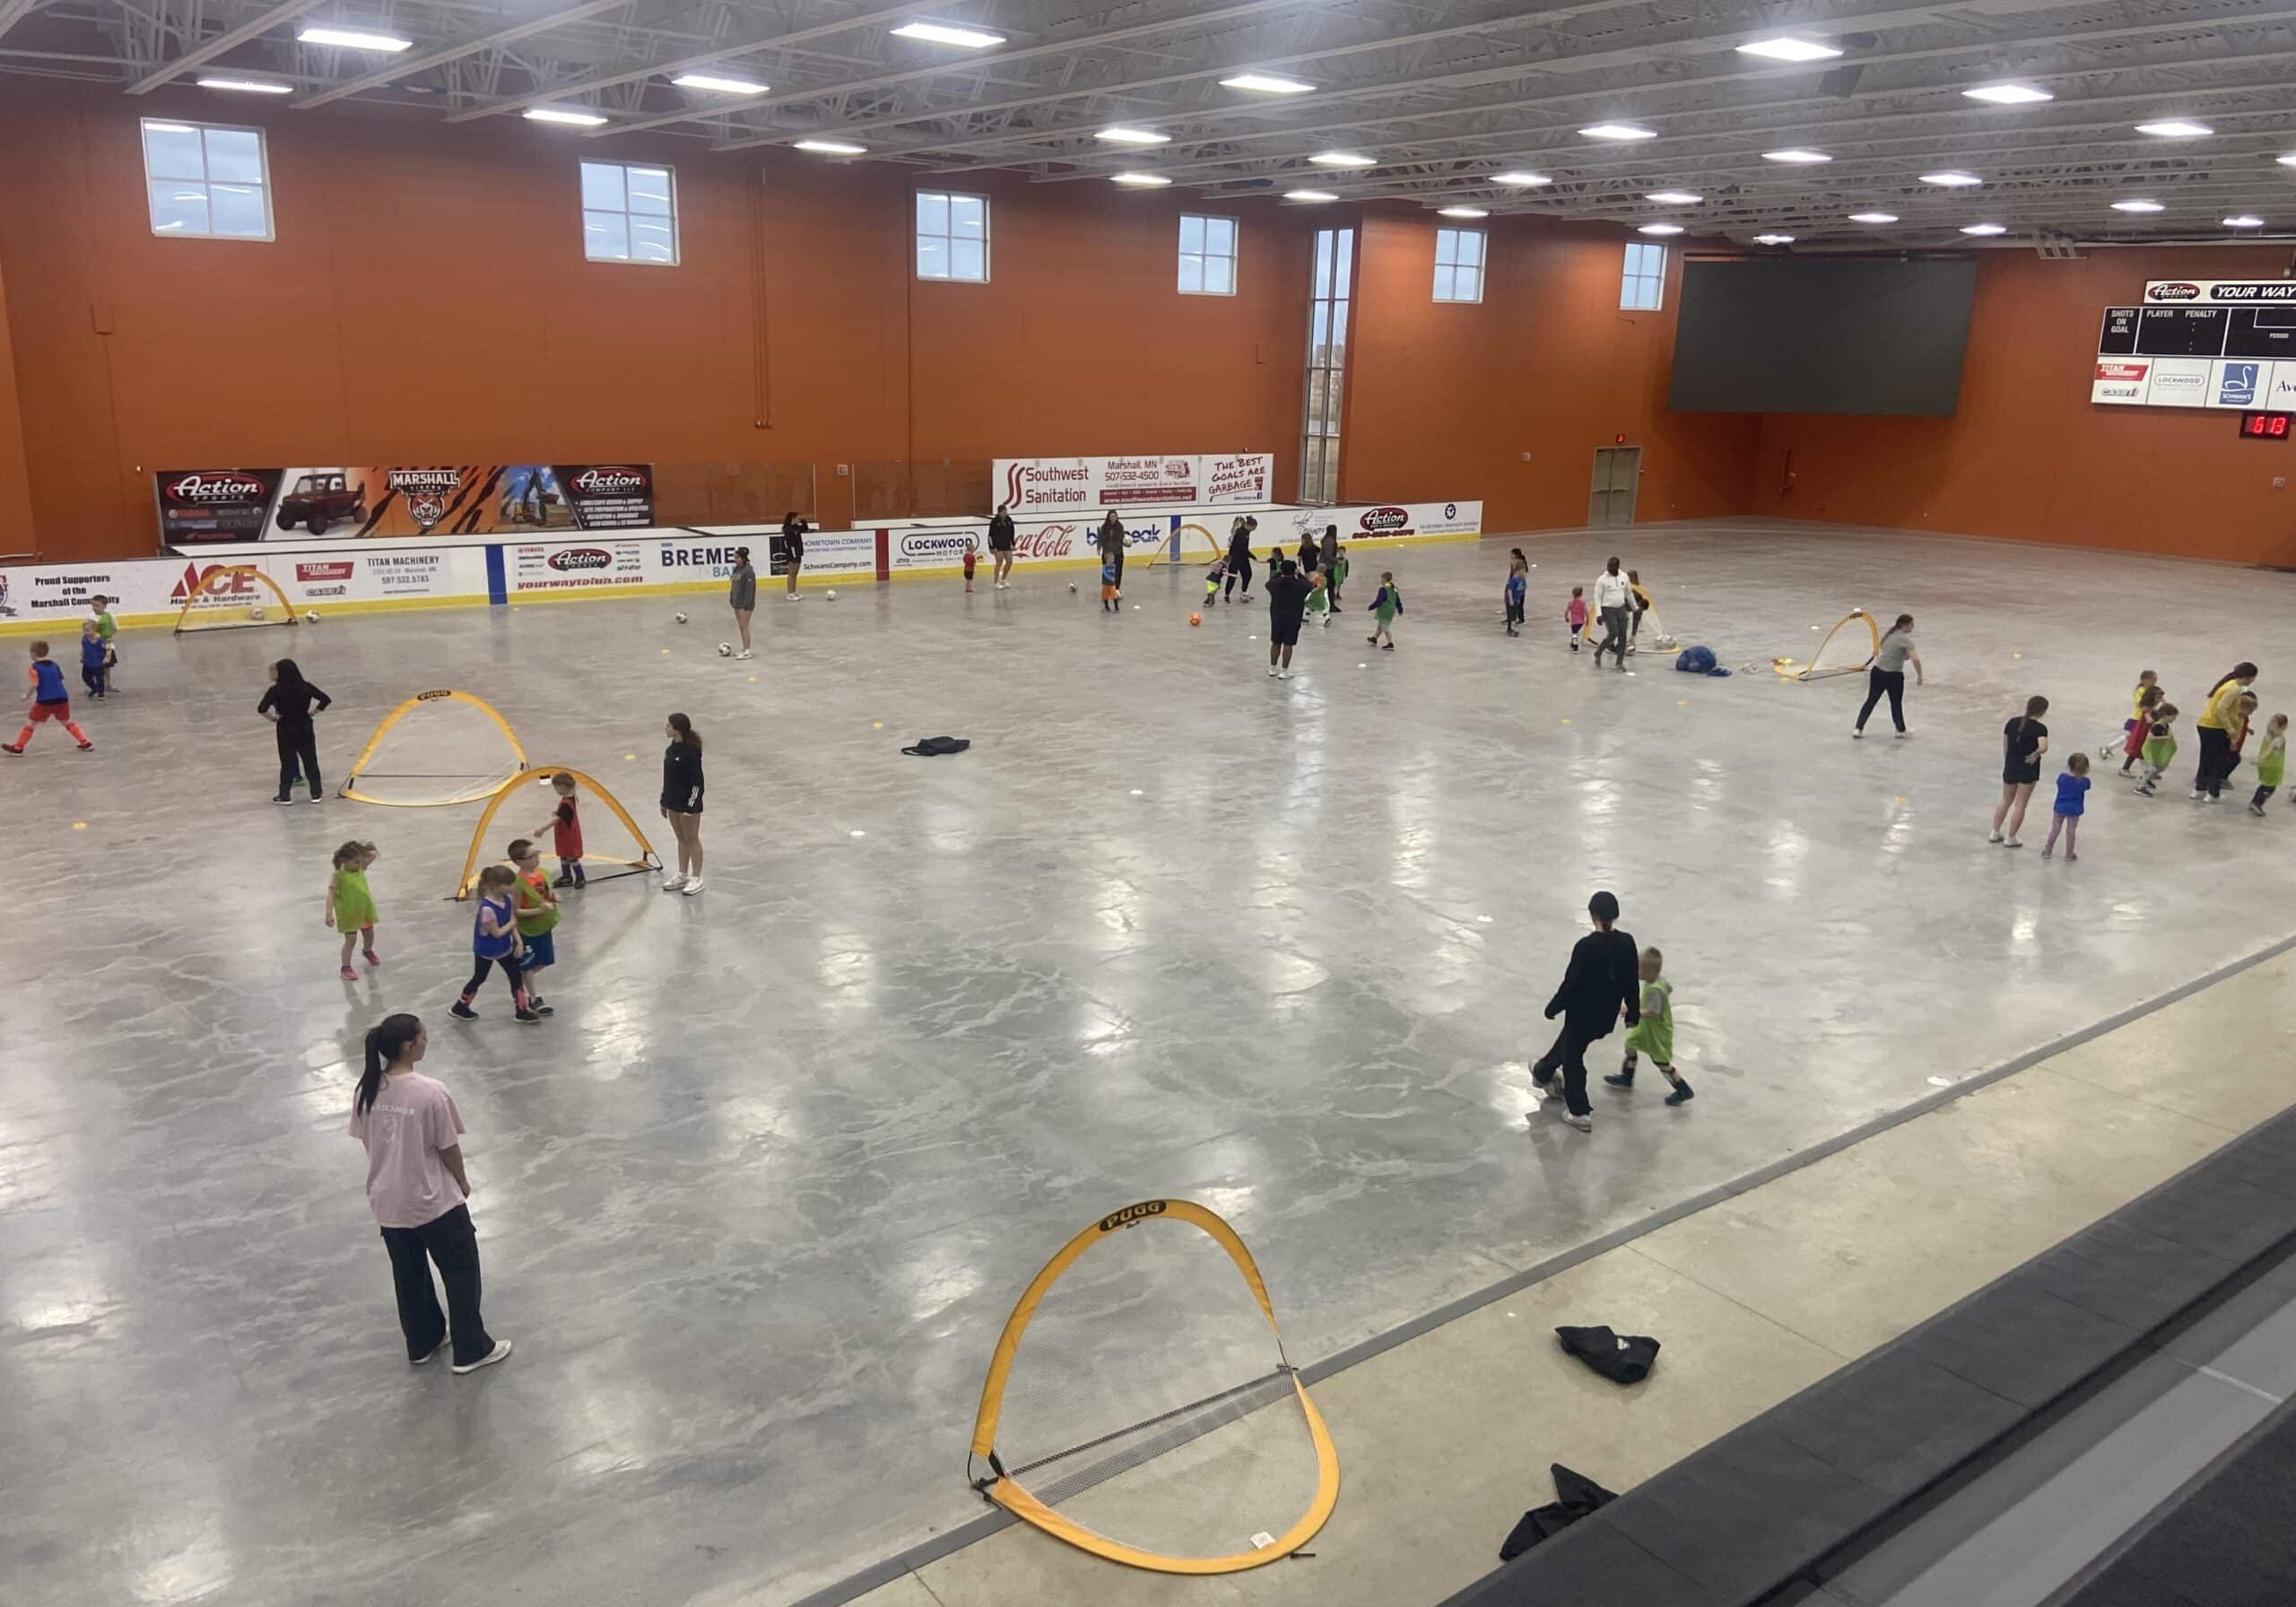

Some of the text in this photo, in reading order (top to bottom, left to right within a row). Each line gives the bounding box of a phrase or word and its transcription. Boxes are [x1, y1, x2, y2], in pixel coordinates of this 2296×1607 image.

[2152, 283, 2196, 296] Action
[2217, 286, 2296, 298] YOUR WAY
[2110, 309, 2135, 317] SHOTS
[2146, 309, 2218, 318] PLAYER PENALTY
[2117, 317, 2126, 326] ON
[2110, 326, 2129, 334] GOAL
[1144, 460, 1157, 469] MN
[1213, 456, 1264, 472] THE BEST
[392, 473, 457, 487] MARSHALL
[576, 470, 641, 488] Action
[1025, 466, 1090, 482] Southwest
[1104, 471, 1160, 481] 507-532-4500
[1212, 466, 1265, 482] GOALS ARE
[173, 475, 258, 496] Action
[1208, 479, 1252, 494] GARBAGE
[1025, 488, 1086, 503] Sanitation
[1364, 509, 1405, 525] Action
[1013, 525, 1076, 558] ca-Cola
[1086, 524, 1161, 546] bleak
[909, 538, 973, 550] LOCKWOOD
[367, 556, 439, 567] TITAN MACHINERY
[554, 551, 607, 566] Action
[170, 561, 257, 596] ACE
[712, 566, 735, 578] BA
[35, 575, 110, 586] Proud Supporters
[517, 576, 643, 590] yourwaytofun.com
[62, 586, 86, 595] of the
[30, 595, 119, 608] Marshall Comity
[213, 595, 261, 603] Hardware
[1106, 1202, 1160, 1229] PUGG
